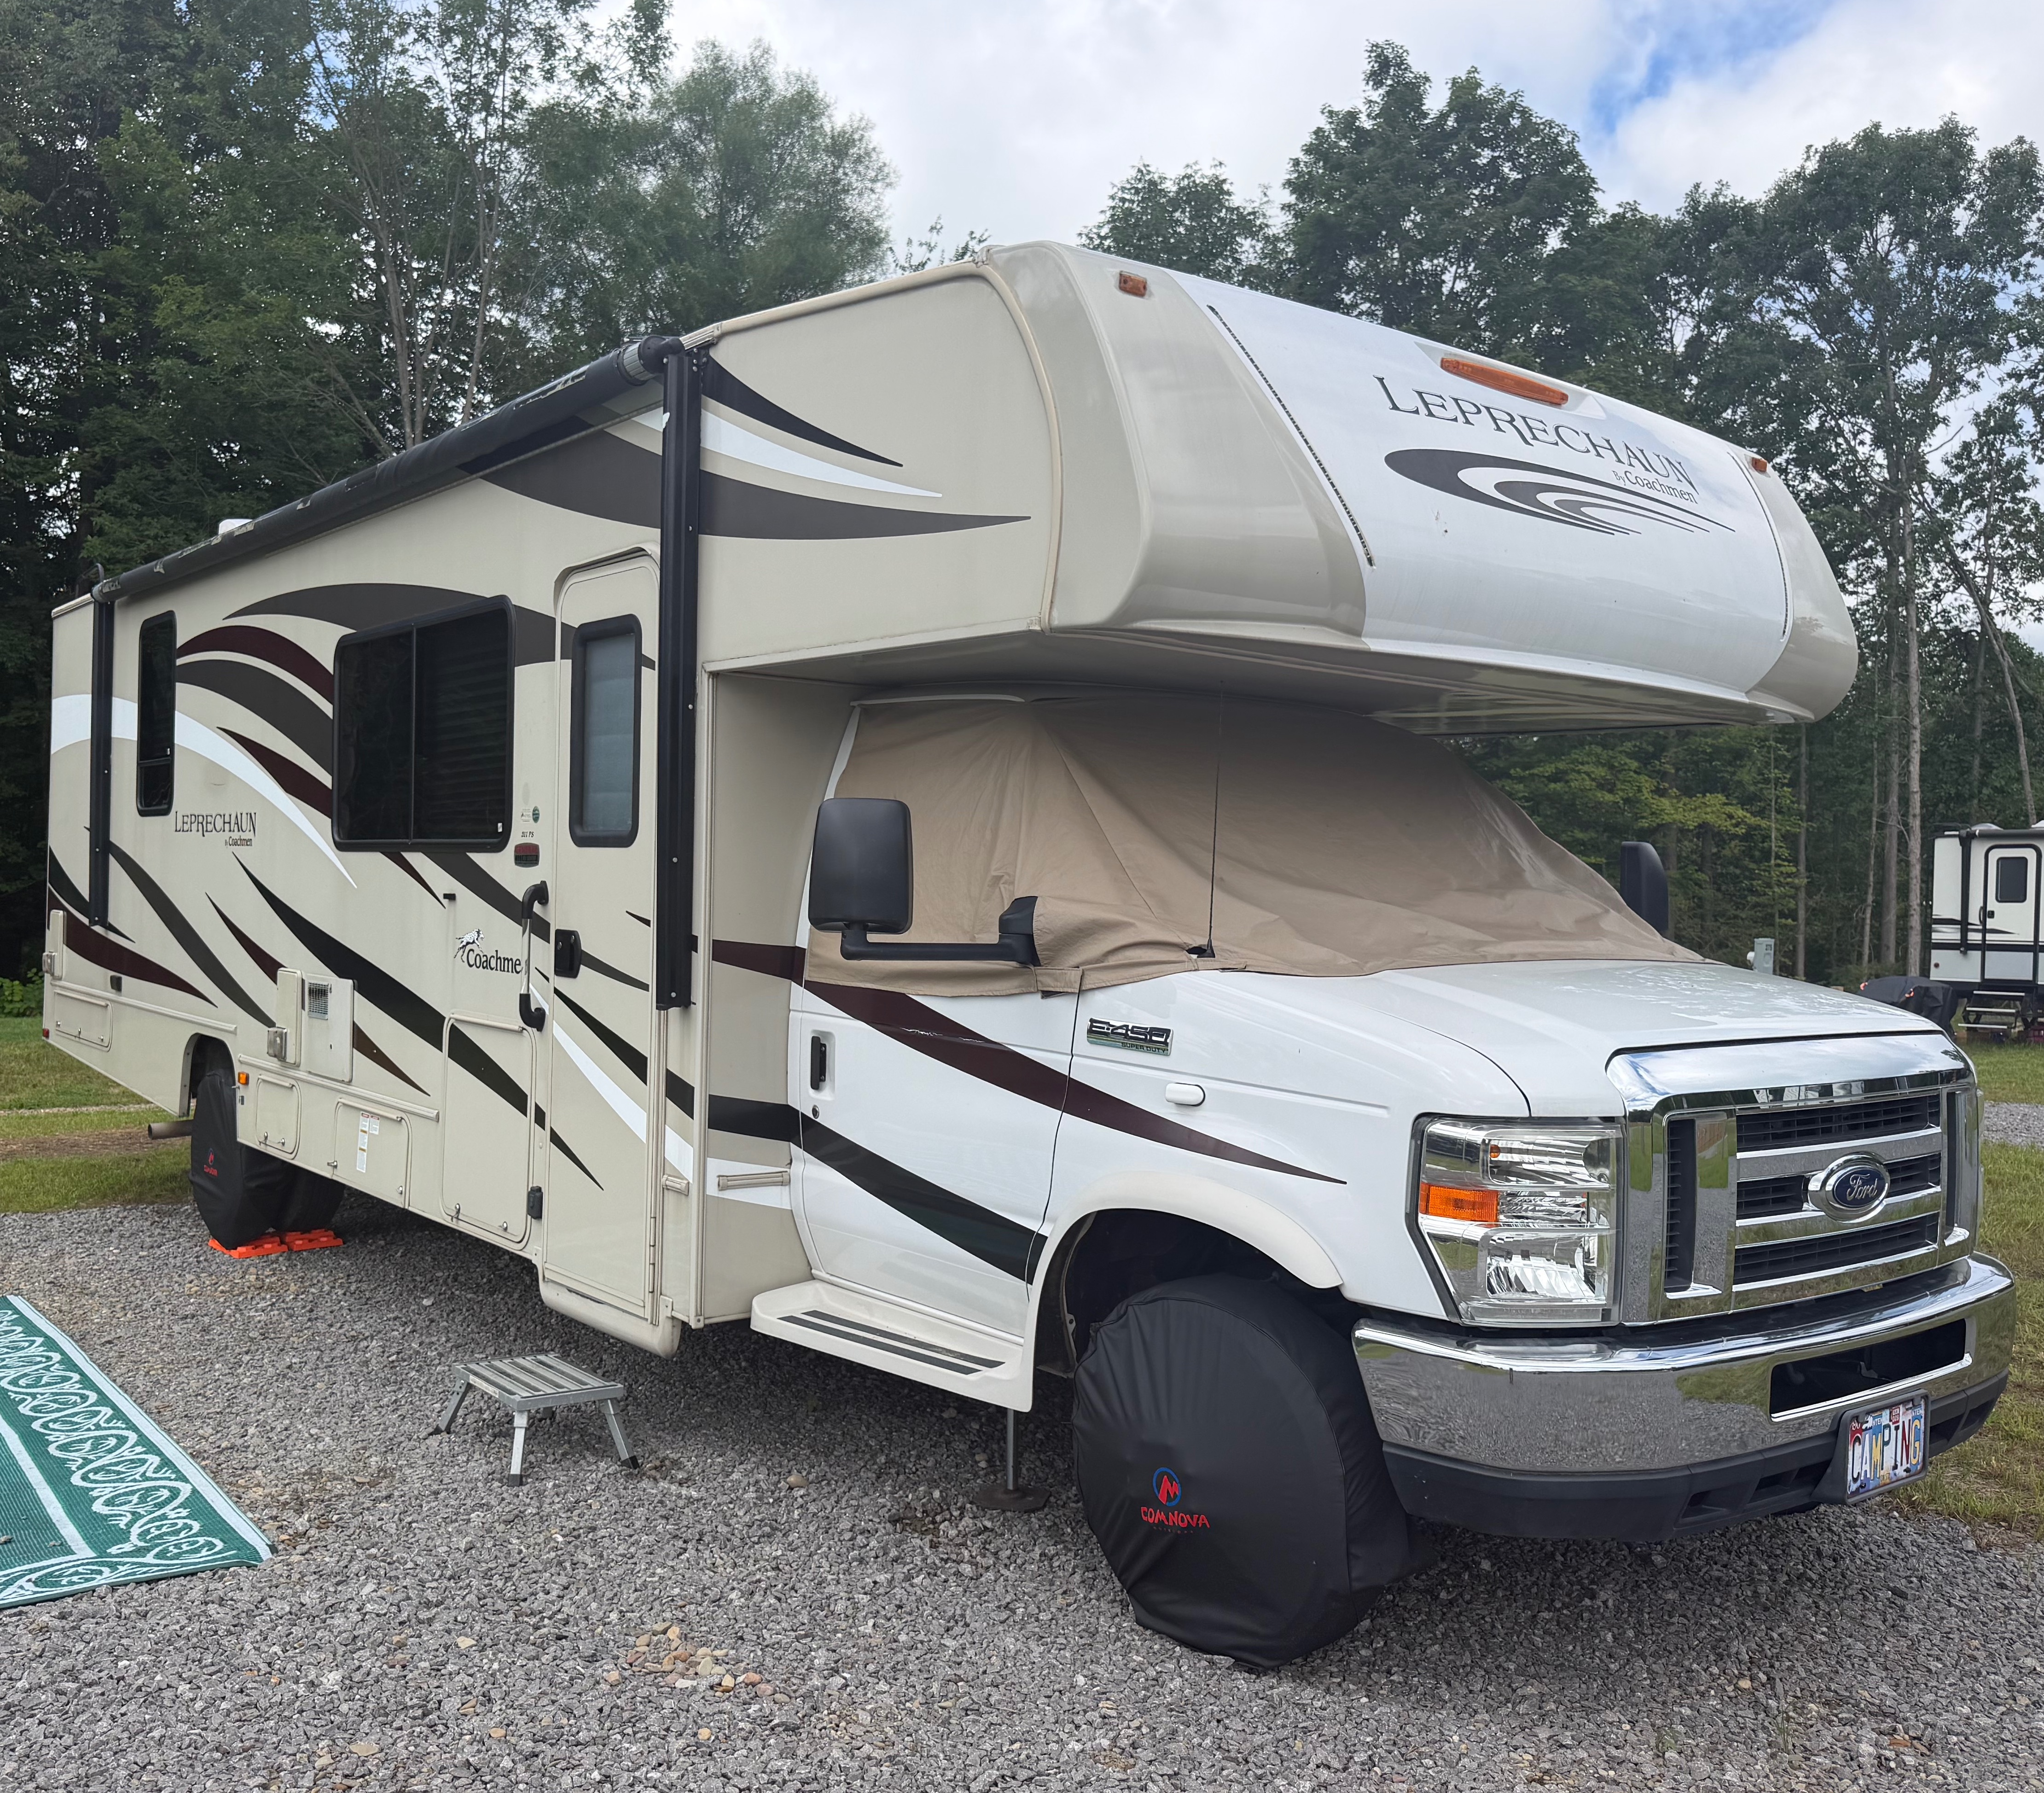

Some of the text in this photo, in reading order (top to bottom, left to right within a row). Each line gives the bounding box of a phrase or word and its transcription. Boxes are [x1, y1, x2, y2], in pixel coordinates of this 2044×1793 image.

[1373, 375, 1699, 495] LEPRECHAUN
[1612, 470, 1698, 504] By Coachmen
[174, 810, 257, 838] LEPRECHAUN
[228, 836, 253, 847] Coachmen
[466, 949, 522, 974] Coachme
[1846, 1173, 1878, 1201] Ford
[1851, 1419, 1921, 1484] CAMPING
[1140, 1506, 1210, 1528] COMNOVA
